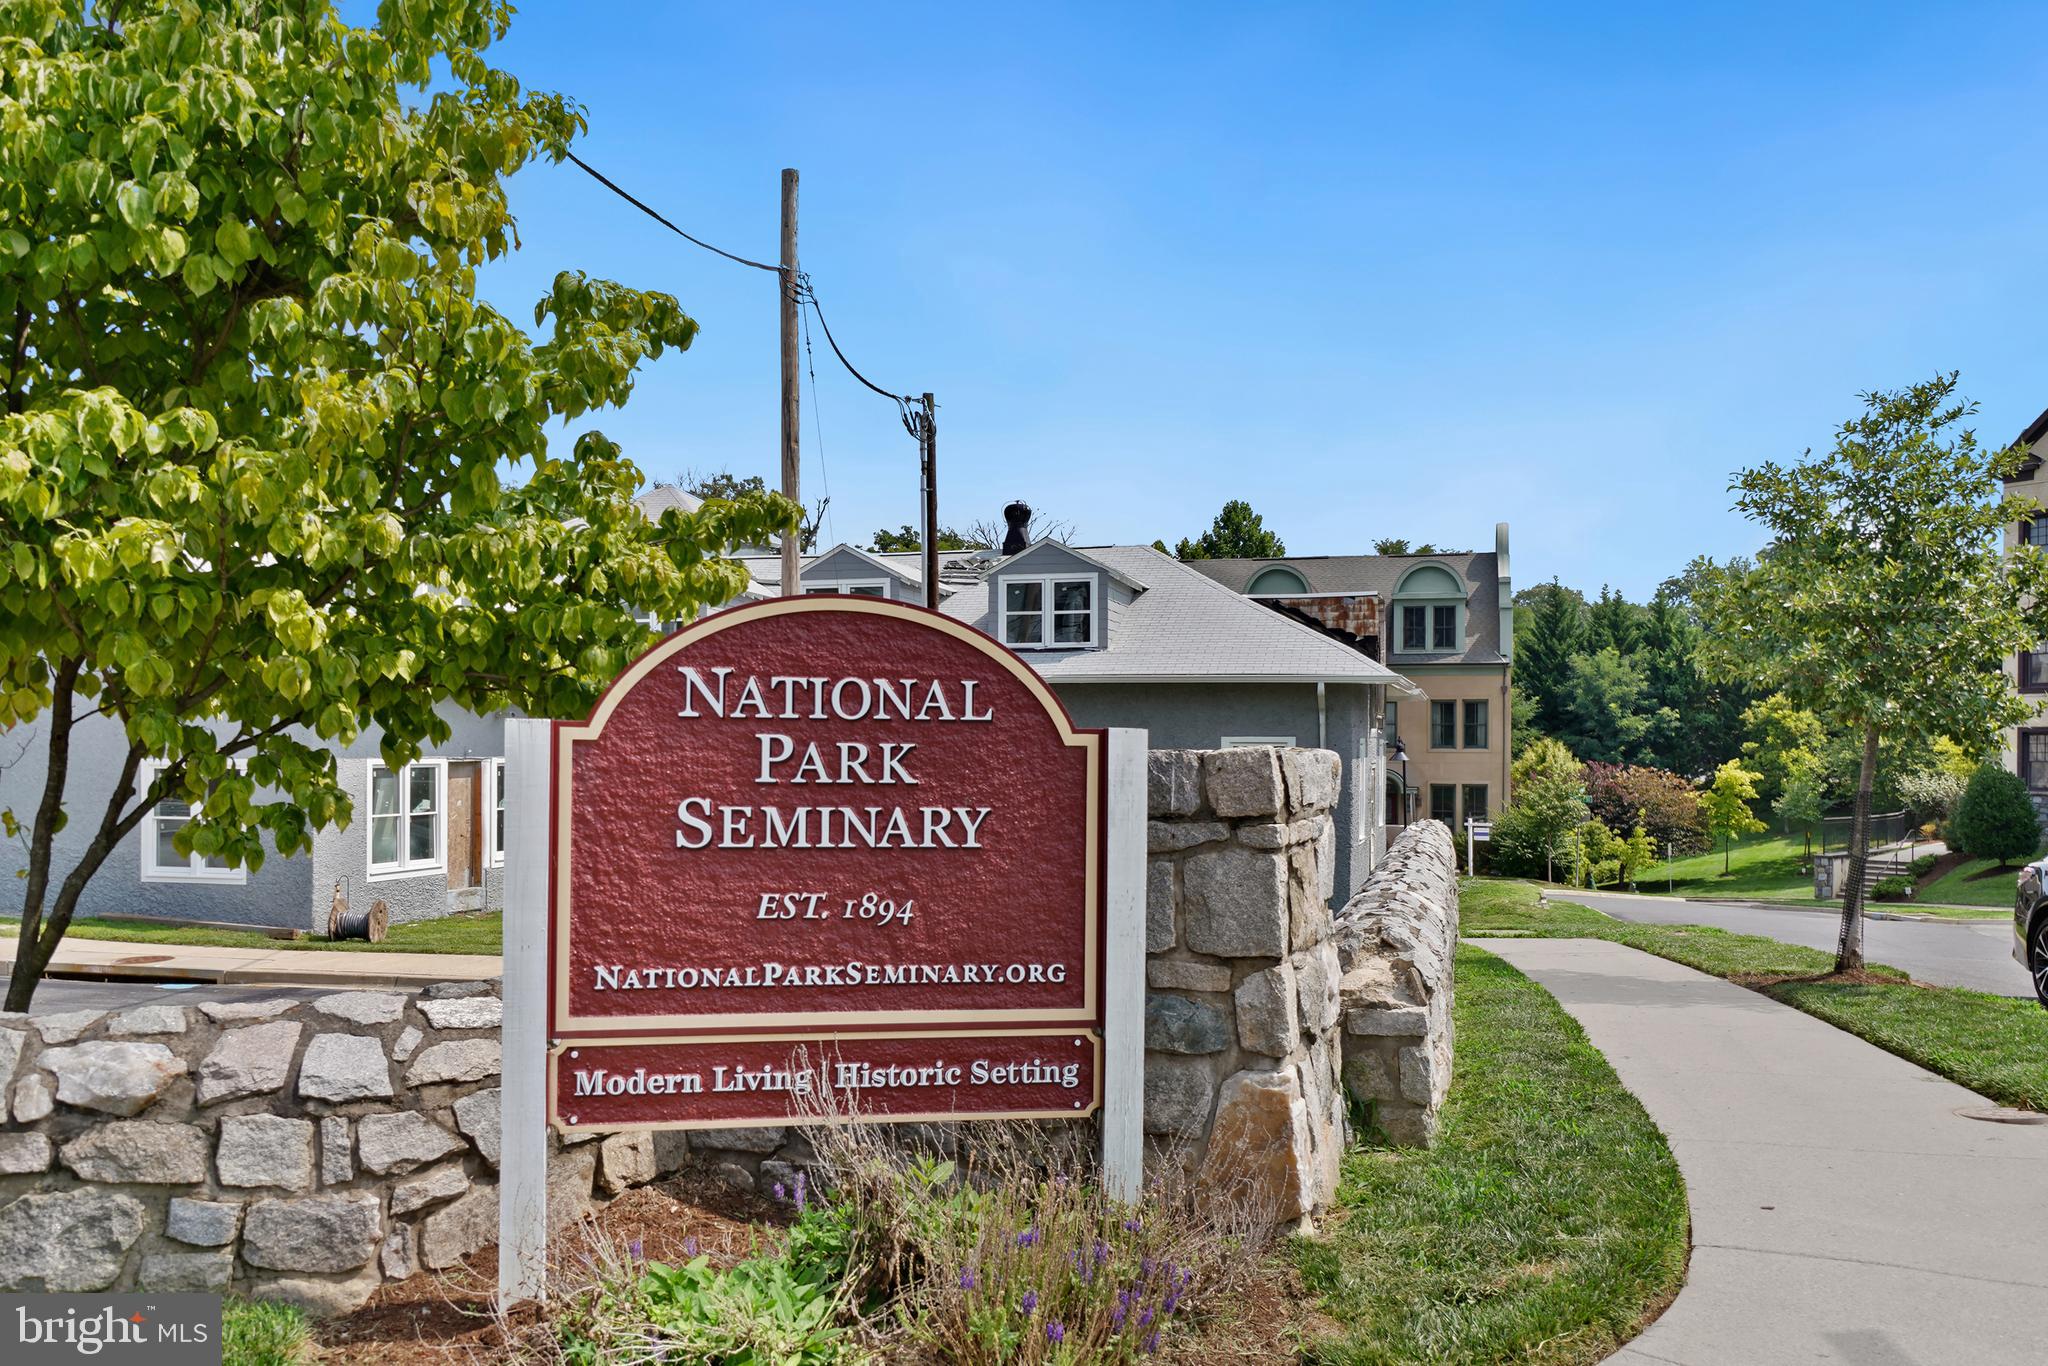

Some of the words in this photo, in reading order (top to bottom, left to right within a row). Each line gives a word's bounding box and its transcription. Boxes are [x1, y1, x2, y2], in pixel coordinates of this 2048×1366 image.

[677, 666, 994, 722] NATIONAL
[754, 733, 919, 785] PARK
[675, 797, 992, 849] SEMINARY
[756, 891, 829, 920] EST.
[842, 891, 914, 926] 1894
[593, 961, 1067, 991] NATIONALPARKSEMINARY.ORG
[574, 1066, 704, 1096] Modern
[712, 1065, 812, 1095] Living
[834, 1060, 961, 1089] Historic
[970, 1059, 1080, 1088] Setting
